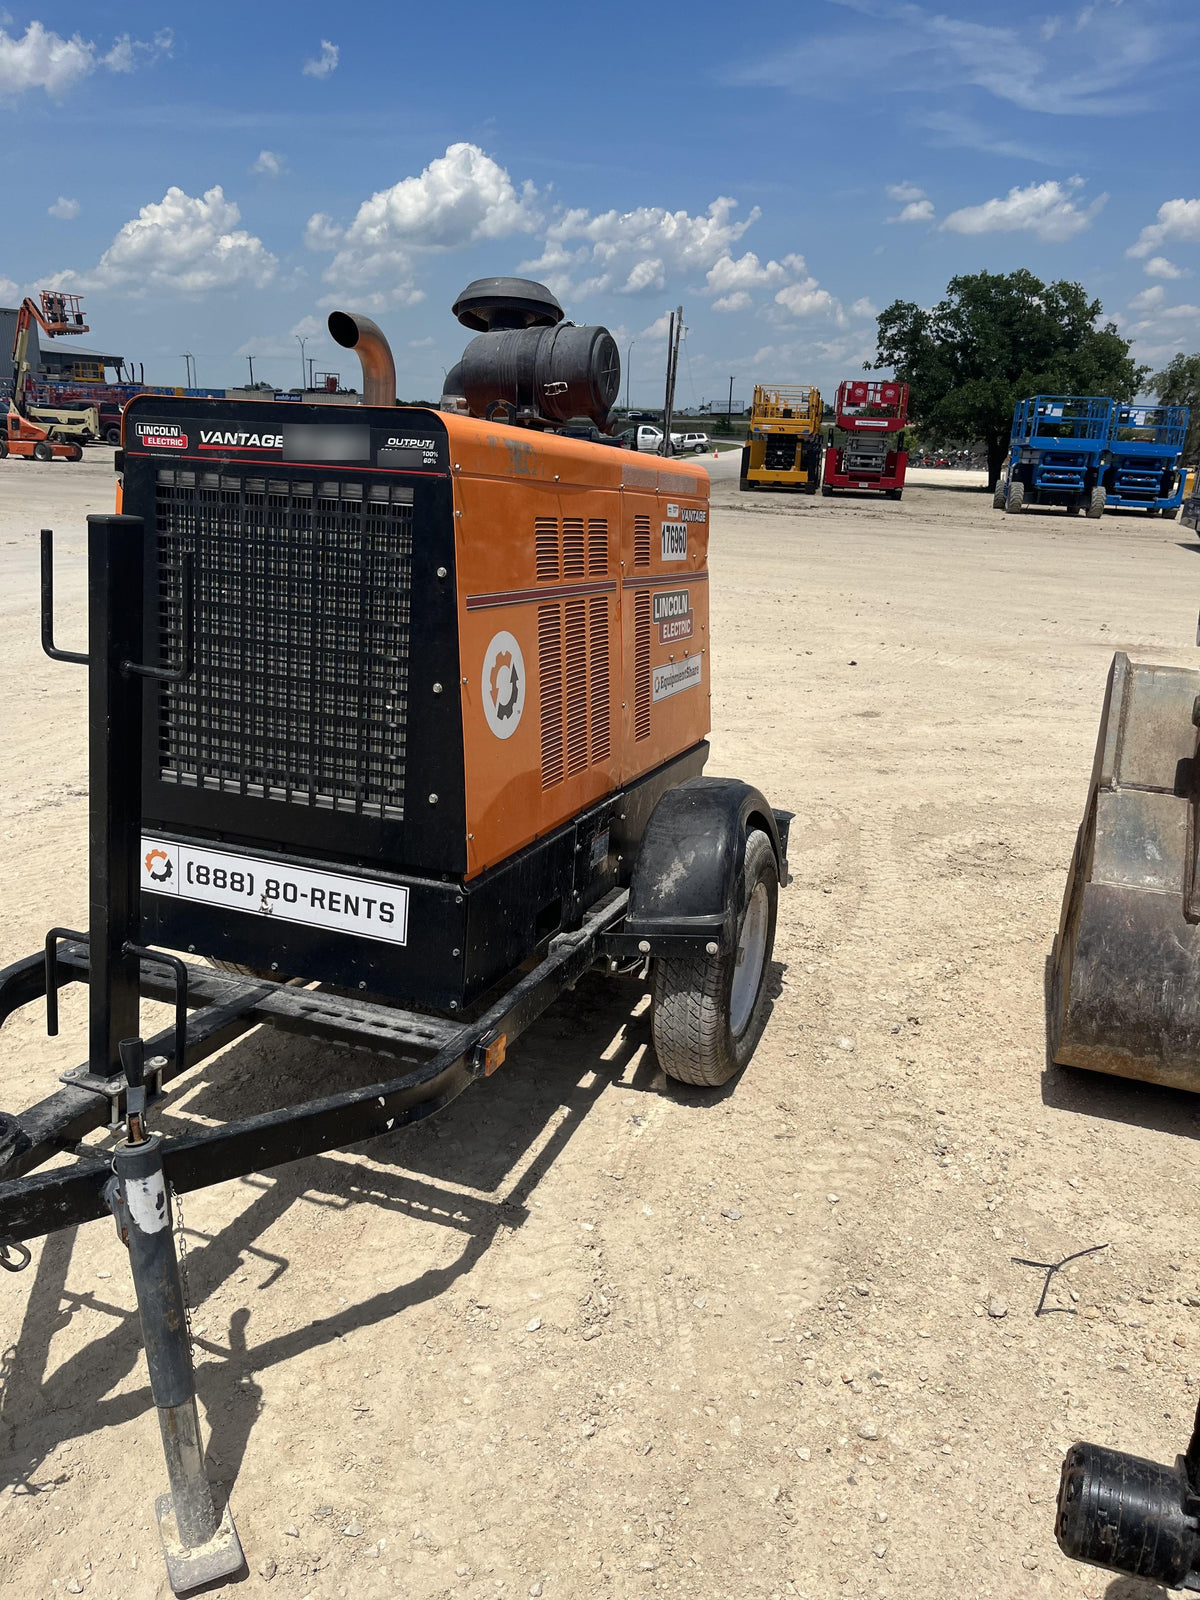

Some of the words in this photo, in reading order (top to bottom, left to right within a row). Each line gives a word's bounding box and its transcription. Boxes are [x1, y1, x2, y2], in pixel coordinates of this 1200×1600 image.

[138, 425, 178, 437] LINCOLN
[200, 430, 283, 448] VANTAGE
[148, 437, 183, 446] ELECTRIC
[387, 437, 432, 447] OUTPUT
[681, 509, 706, 522] VANTAGE
[661, 524, 687, 554] 176960
[655, 594, 688, 619] LINCOLN
[663, 619, 691, 639] ELECTRIC
[660, 665, 699, 690] EquipmentShare
[186, 861, 254, 896] (888)
[265, 879, 395, 923] 80-RENTS
